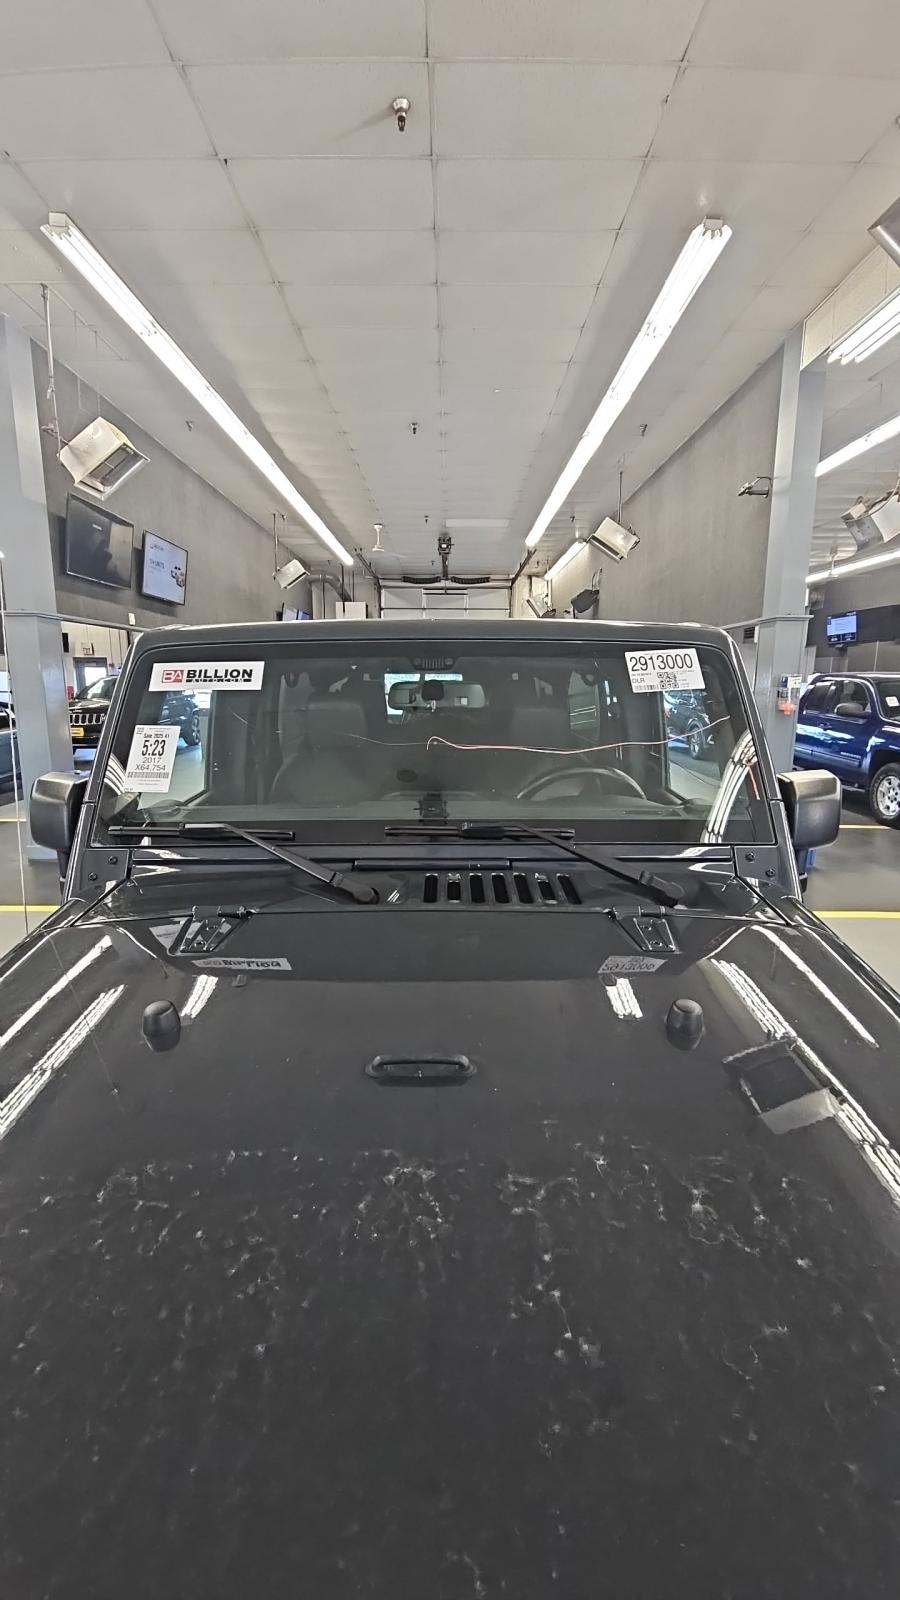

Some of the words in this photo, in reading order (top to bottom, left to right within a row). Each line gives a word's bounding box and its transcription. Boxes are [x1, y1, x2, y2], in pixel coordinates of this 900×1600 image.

[629, 653, 693, 672] 2913000
[186, 669, 253, 679] BILLION
[141, 739, 166, 757] 5:23
[142, 756, 162, 764] 2017
